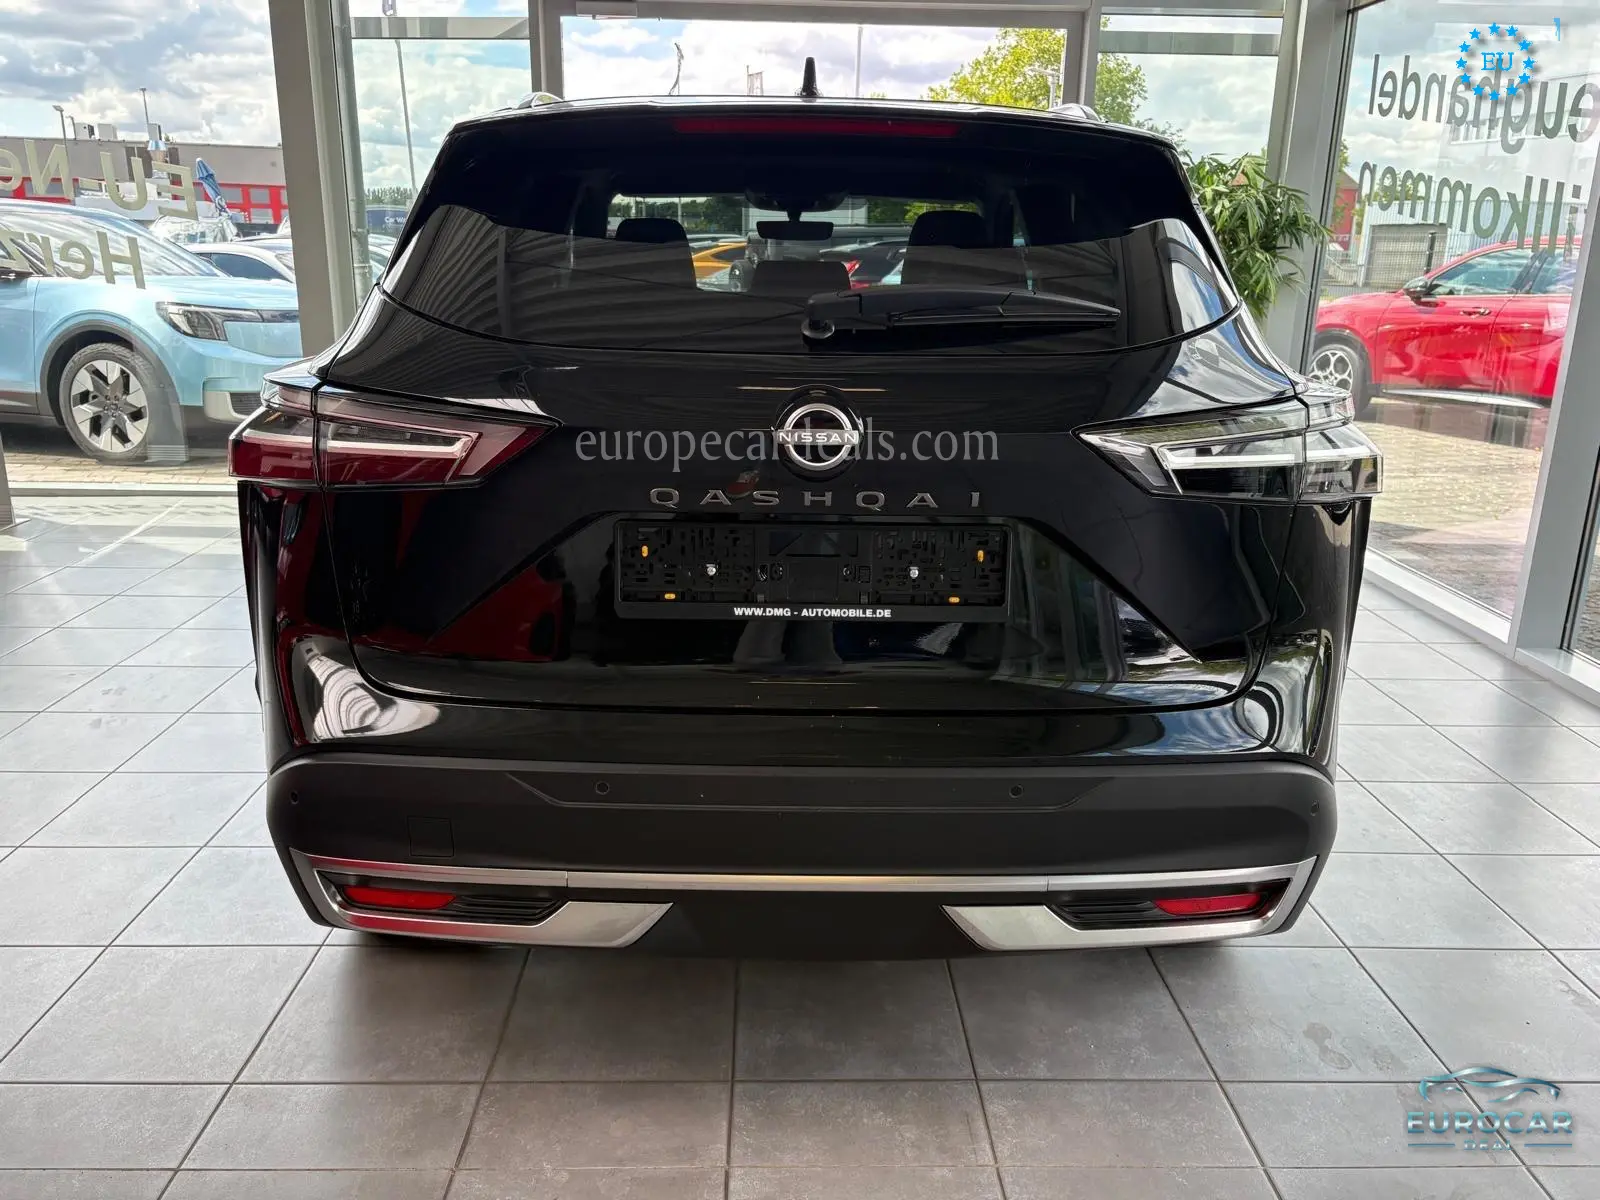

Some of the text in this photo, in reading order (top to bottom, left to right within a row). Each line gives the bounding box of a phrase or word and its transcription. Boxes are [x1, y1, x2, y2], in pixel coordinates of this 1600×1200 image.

[779, 431, 857, 443] NISSAN
[649, 487, 981, 512] QASHQAI
[733, 607, 791, 617] WWW.DMG
[801, 608, 892, 618] AUTOMOBILE.DE
